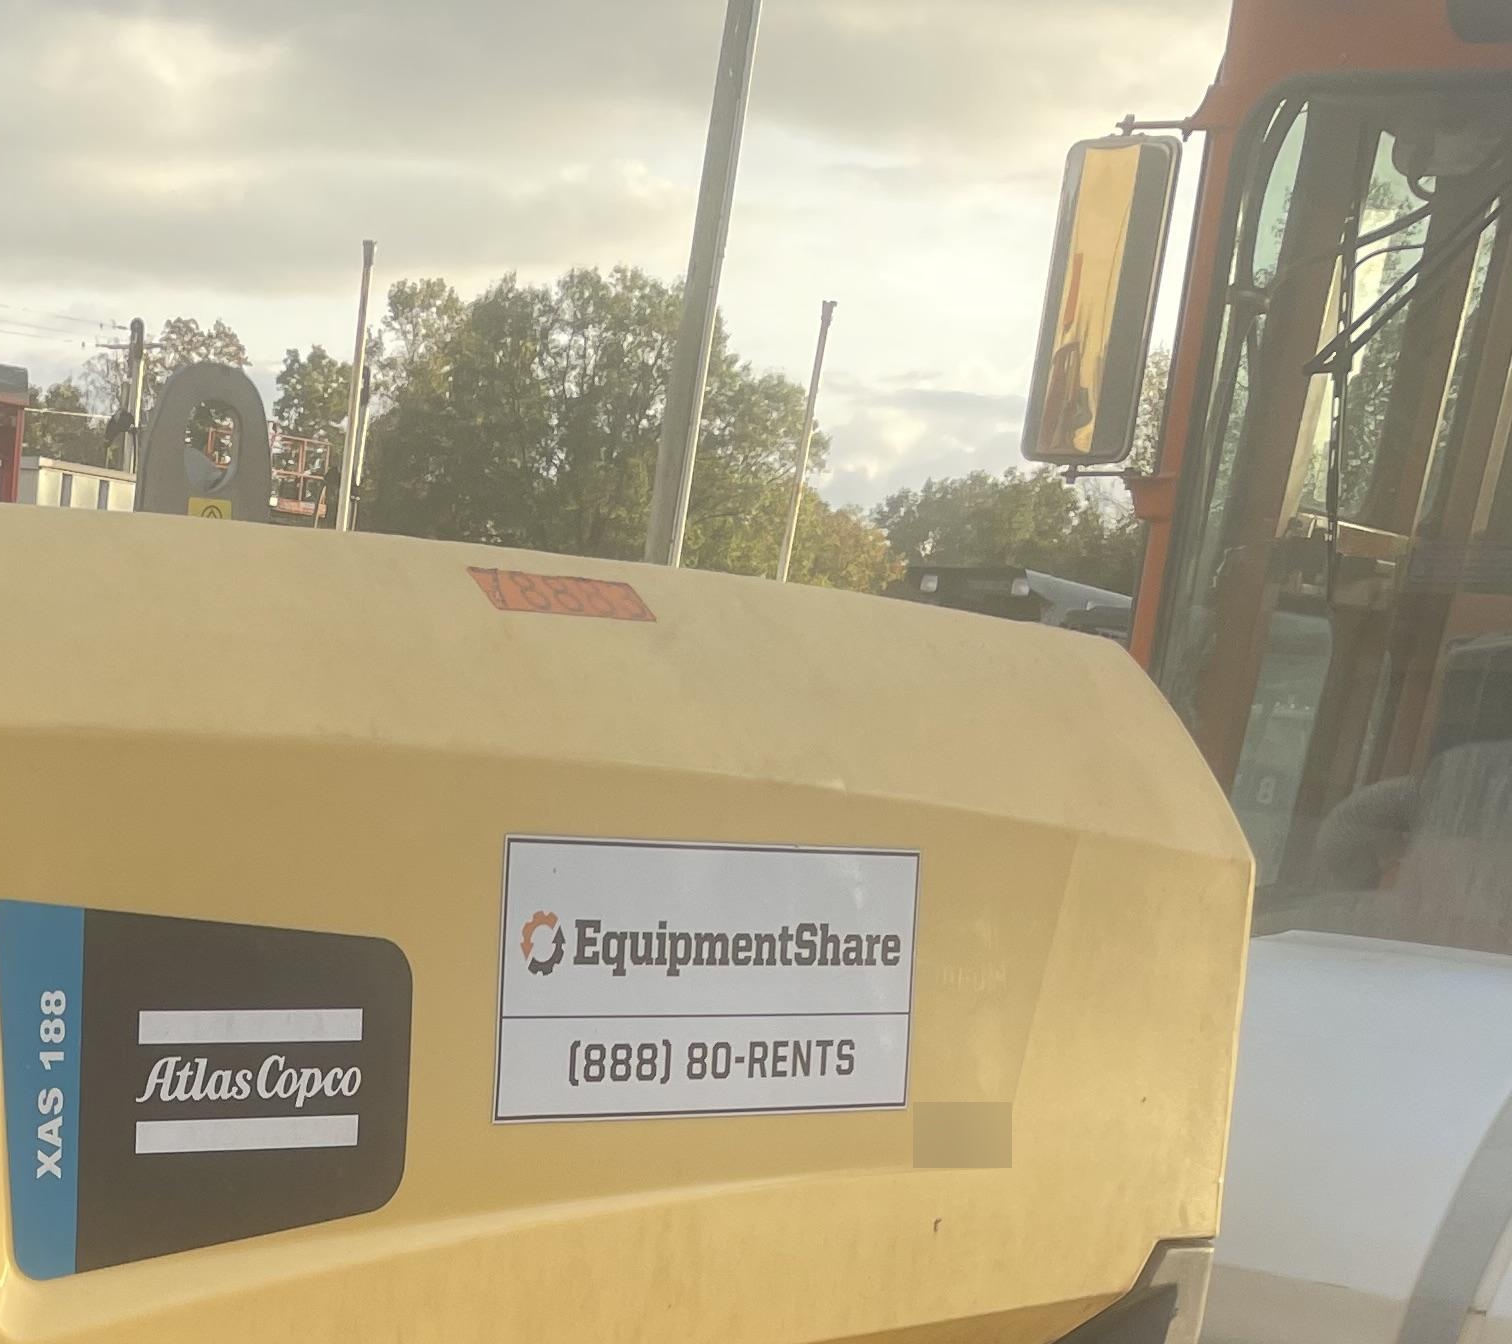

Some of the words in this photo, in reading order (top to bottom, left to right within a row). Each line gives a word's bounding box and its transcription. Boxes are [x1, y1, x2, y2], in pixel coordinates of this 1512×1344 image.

[573, 918, 901, 977] EquipmentShare
[39, 990, 67, 1071] 188
[135, 1055, 252, 1104] Atlas
[256, 1054, 361, 1108] Copco
[569, 1039, 672, 1087] (888)
[686, 1039, 856, 1080] 80-RENTS
[35, 1087, 65, 1180] XAS
